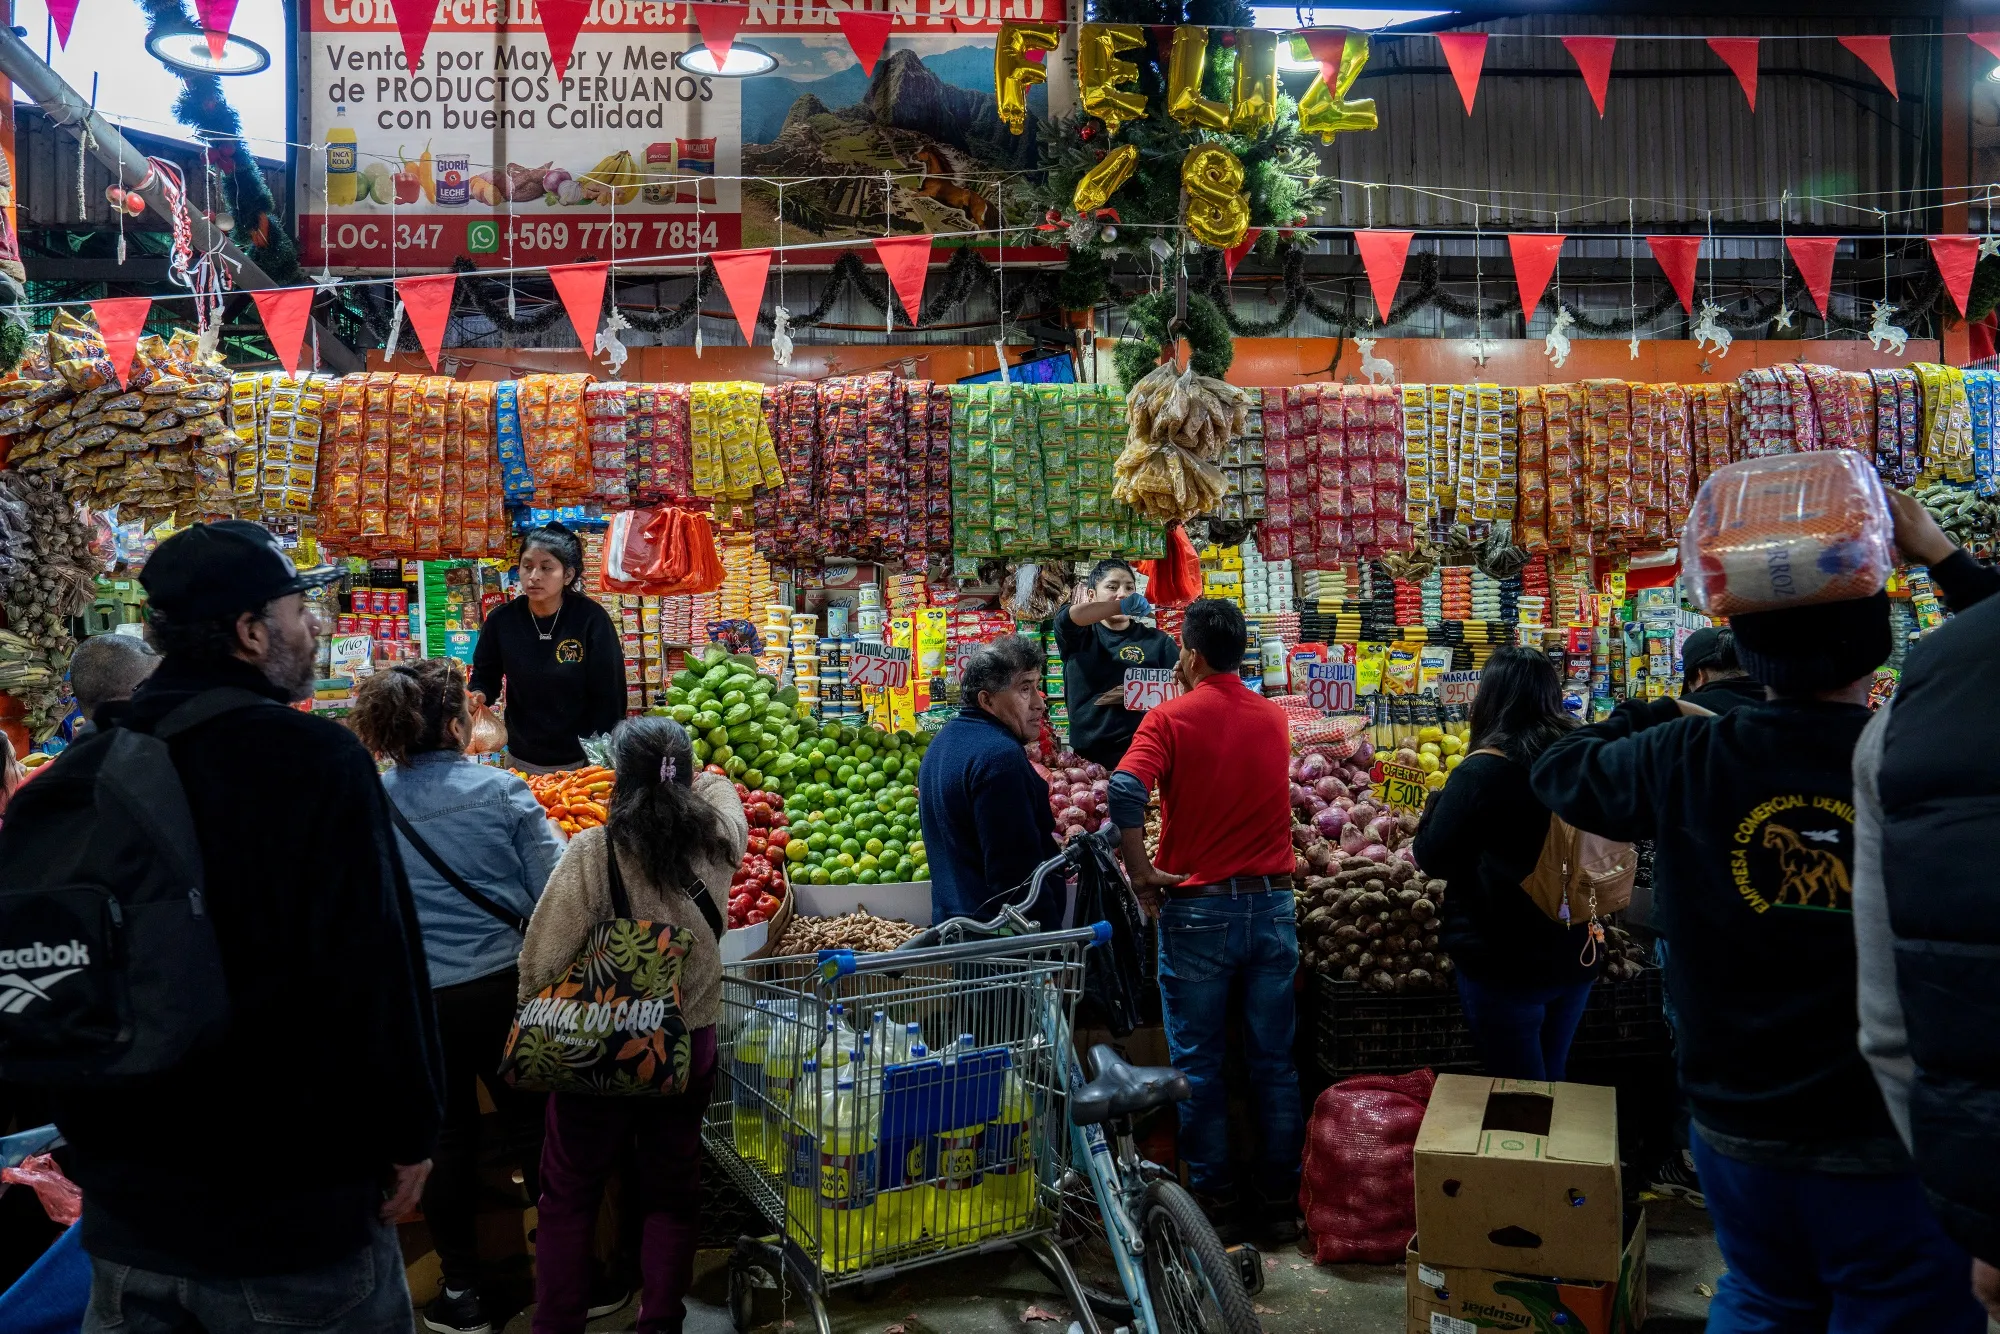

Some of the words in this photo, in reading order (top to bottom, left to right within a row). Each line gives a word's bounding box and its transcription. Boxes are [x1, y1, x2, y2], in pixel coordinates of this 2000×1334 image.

[437, 51, 484, 76] por
[597, 51, 613, 76] y
[329, 77, 365, 102] de
[377, 76, 550, 102] PRODUCTOS
[562, 76, 713, 101] PERUANOS
[994, 22, 1379, 146] FELIZ
[377, 108, 431, 129] con
[443, 104, 535, 129] buena
[547, 103, 663, 129] Calidad
[437, 159, 469, 172] GLORIA
[440, 187, 465, 196] LECHE
[320, 224, 387, 249] LOC.
[397, 224, 444, 249] 347
[503, 222, 569, 250] +569
[577, 222, 643, 249] 7787
[652, 221, 719, 249] 7854
[337, 638, 363, 655] VIVO
[1309, 663, 1355, 681] CEBOLLA
[1442, 671, 1482, 682] MARACU
[1309, 678, 1353, 711] 800
[1445, 682, 1480, 703] 250
[1382, 762, 1425, 784] OFERTA
[1382, 778, 1423, 808] 1300
[1734, 795, 1809, 844] COMERCIAL
[1812, 796, 1857, 824] DENIL
[1730, 849, 1770, 914] EMPRESA
[0, 939, 91, 971] eebok
[519, 996, 583, 1031] ARRAIAL
[583, 1001, 611, 1033] DO
[614, 998, 665, 1032] CABO
